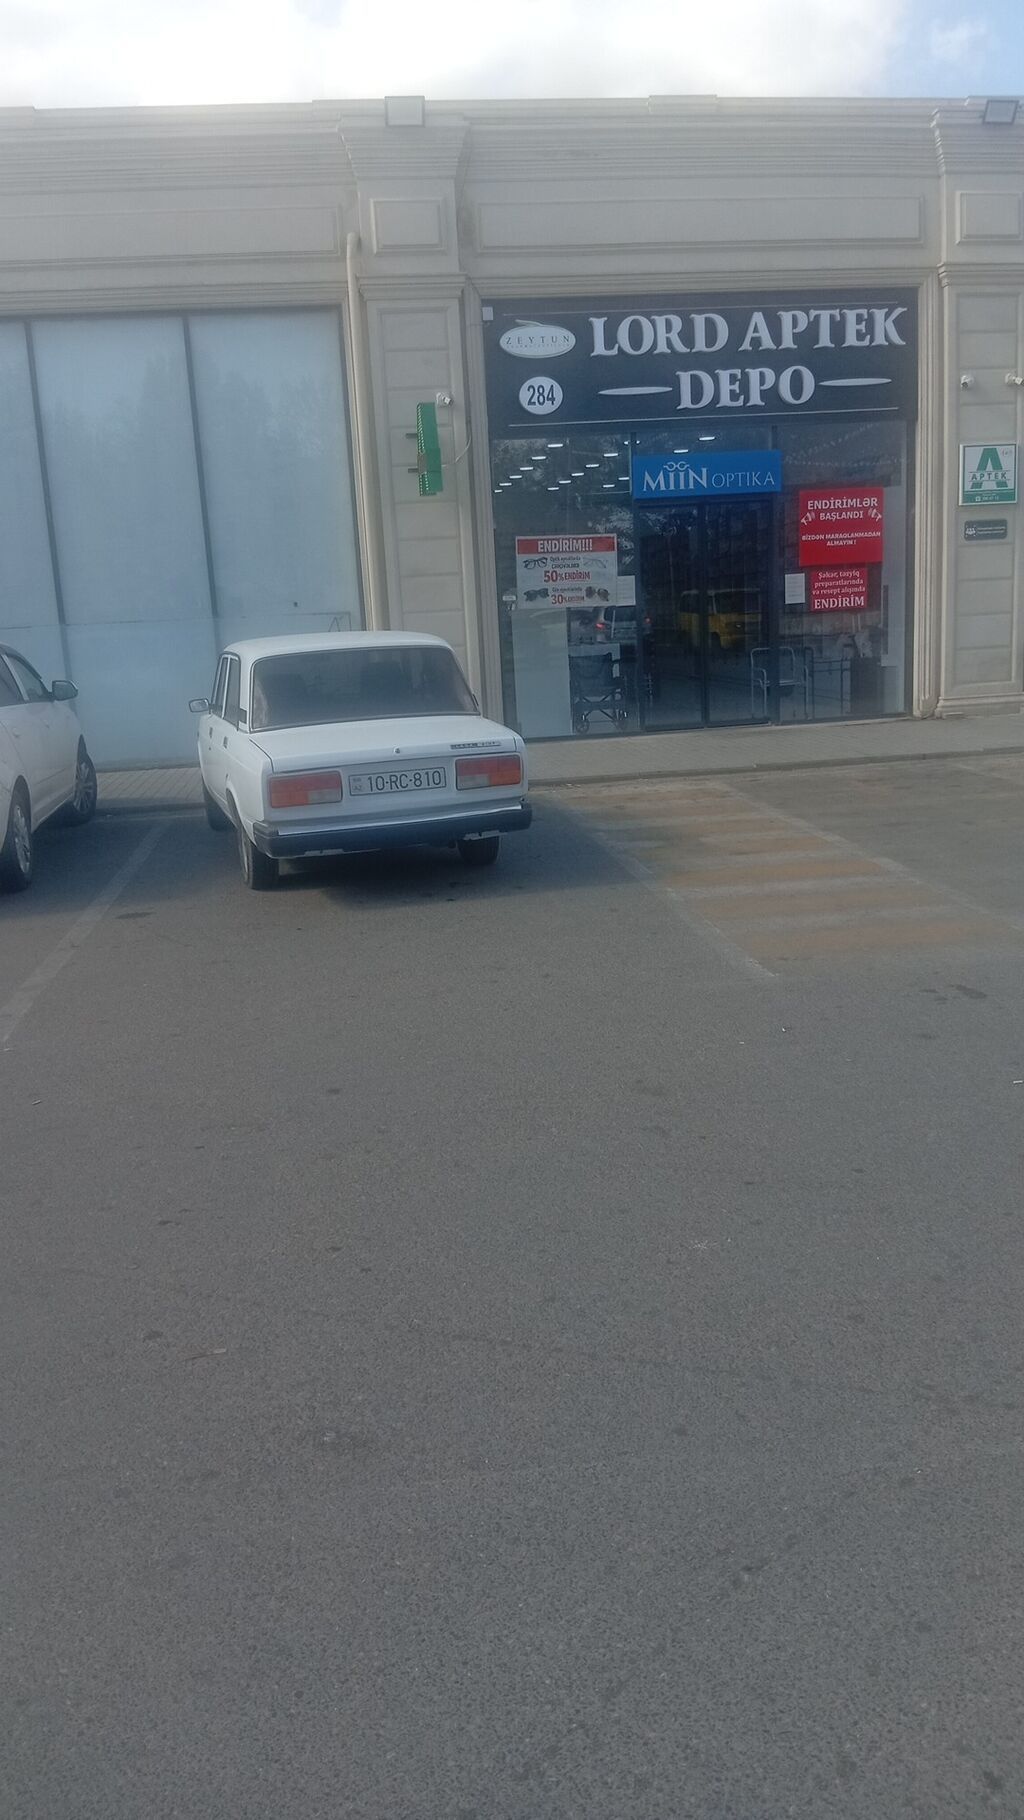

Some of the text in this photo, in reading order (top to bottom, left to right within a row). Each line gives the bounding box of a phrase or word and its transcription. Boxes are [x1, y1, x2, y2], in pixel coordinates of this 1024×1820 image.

[588, 307, 908, 357] LORD APTEK
[506, 335, 570, 345] ZEYTUN
[527, 384, 556, 406] 284
[675, 365, 816, 411] DEPO
[711, 471, 775, 488] OPTIKA
[971, 472, 1007, 481] APTEK
[807, 496, 878, 510] ENDİRİMLƏR
[819, 511, 864, 521] BAŞLANDI
[537, 537, 593, 553] ENDİRİM!!!
[814, 594, 865, 609] ENDİRİM
